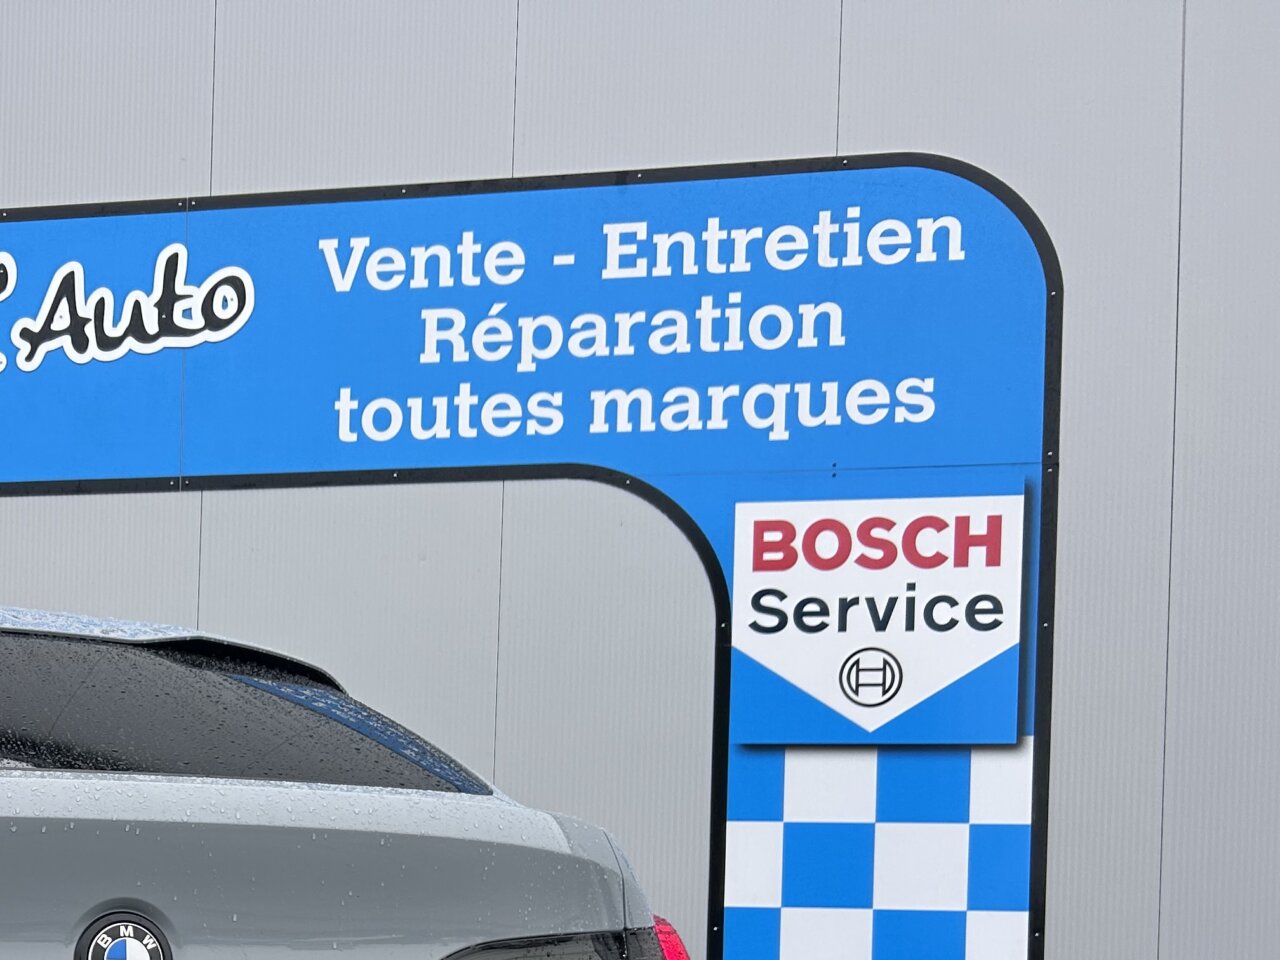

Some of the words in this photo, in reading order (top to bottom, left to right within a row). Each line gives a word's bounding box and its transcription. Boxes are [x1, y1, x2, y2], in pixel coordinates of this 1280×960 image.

[320, 230, 524, 292] Vente
[554, 254, 575, 267] -
[601, 206, 965, 280] Entretien
[420, 292, 845, 372] Réparation
[335, 382, 564, 443] toutes
[589, 376, 936, 441] marques
[752, 515, 1003, 573] BOSCH
[748, 583, 1003, 635] Service
[97, 926, 157, 949] BMW
